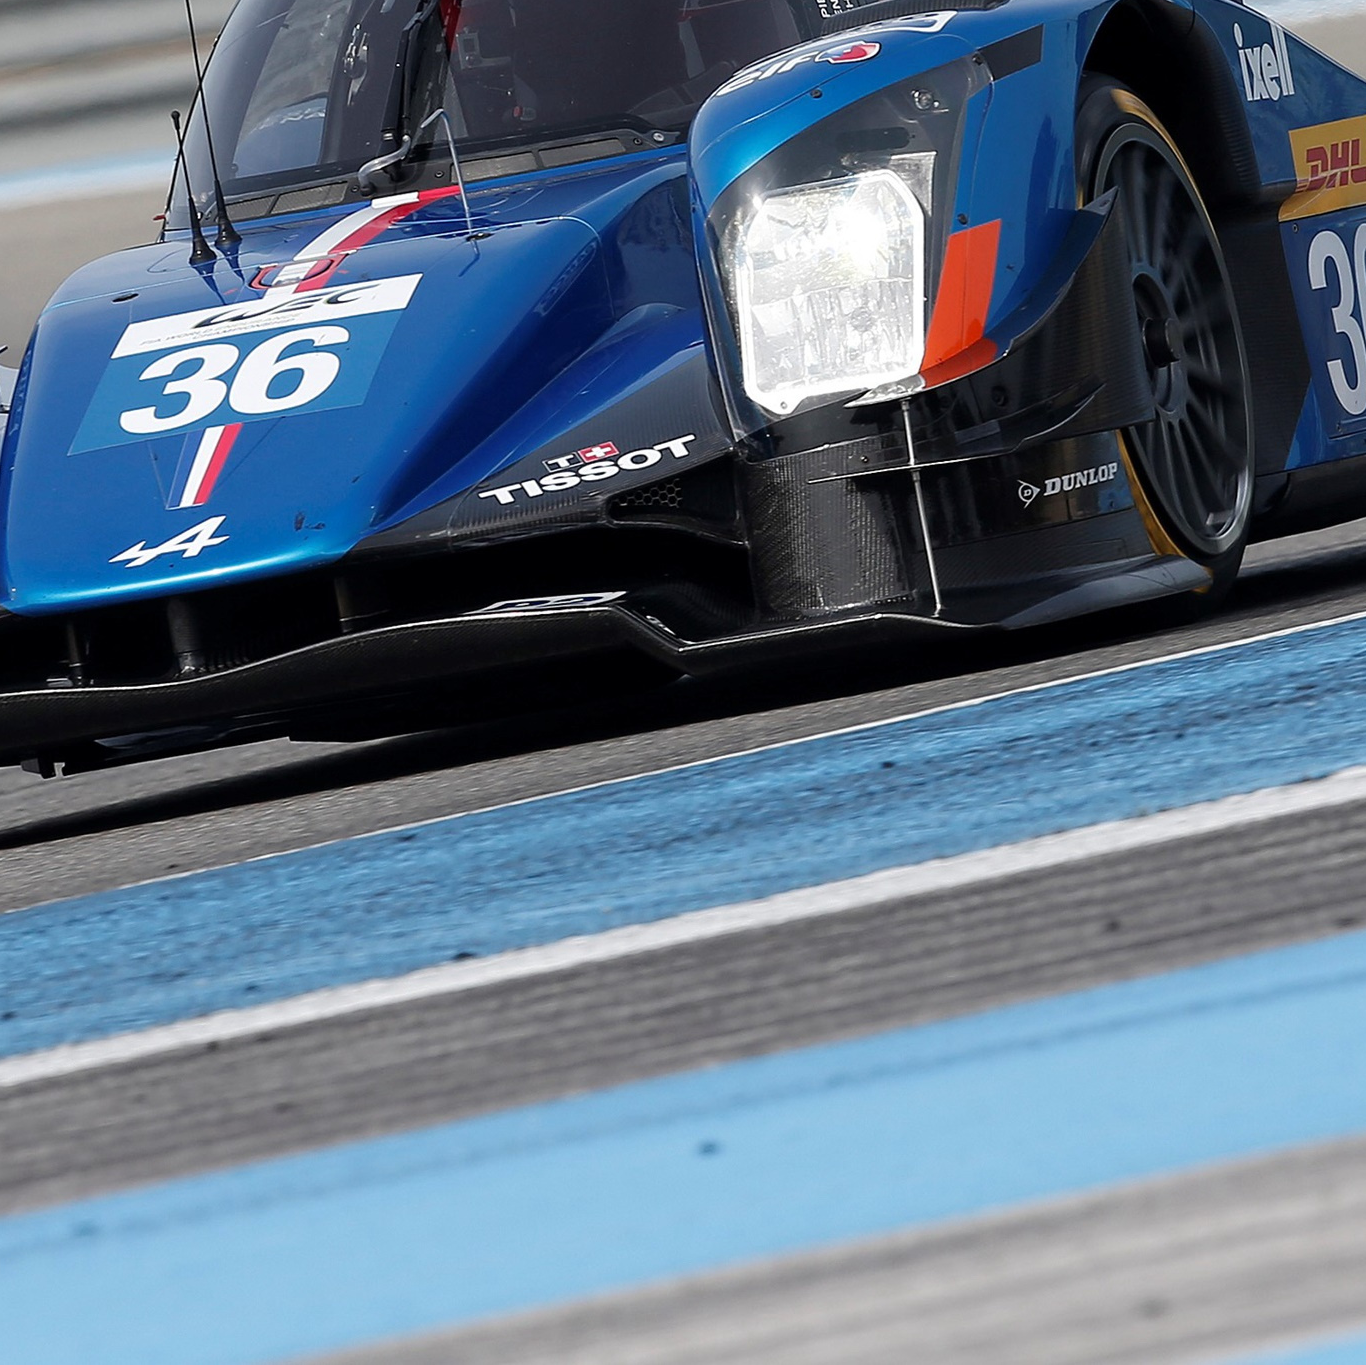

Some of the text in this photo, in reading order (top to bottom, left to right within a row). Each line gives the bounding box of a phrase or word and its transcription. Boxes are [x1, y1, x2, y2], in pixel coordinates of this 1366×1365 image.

[118, 325, 350, 435] 36
[478, 434, 696, 505] TISSOT
[1043, 462, 1118, 496] DUNLOP
